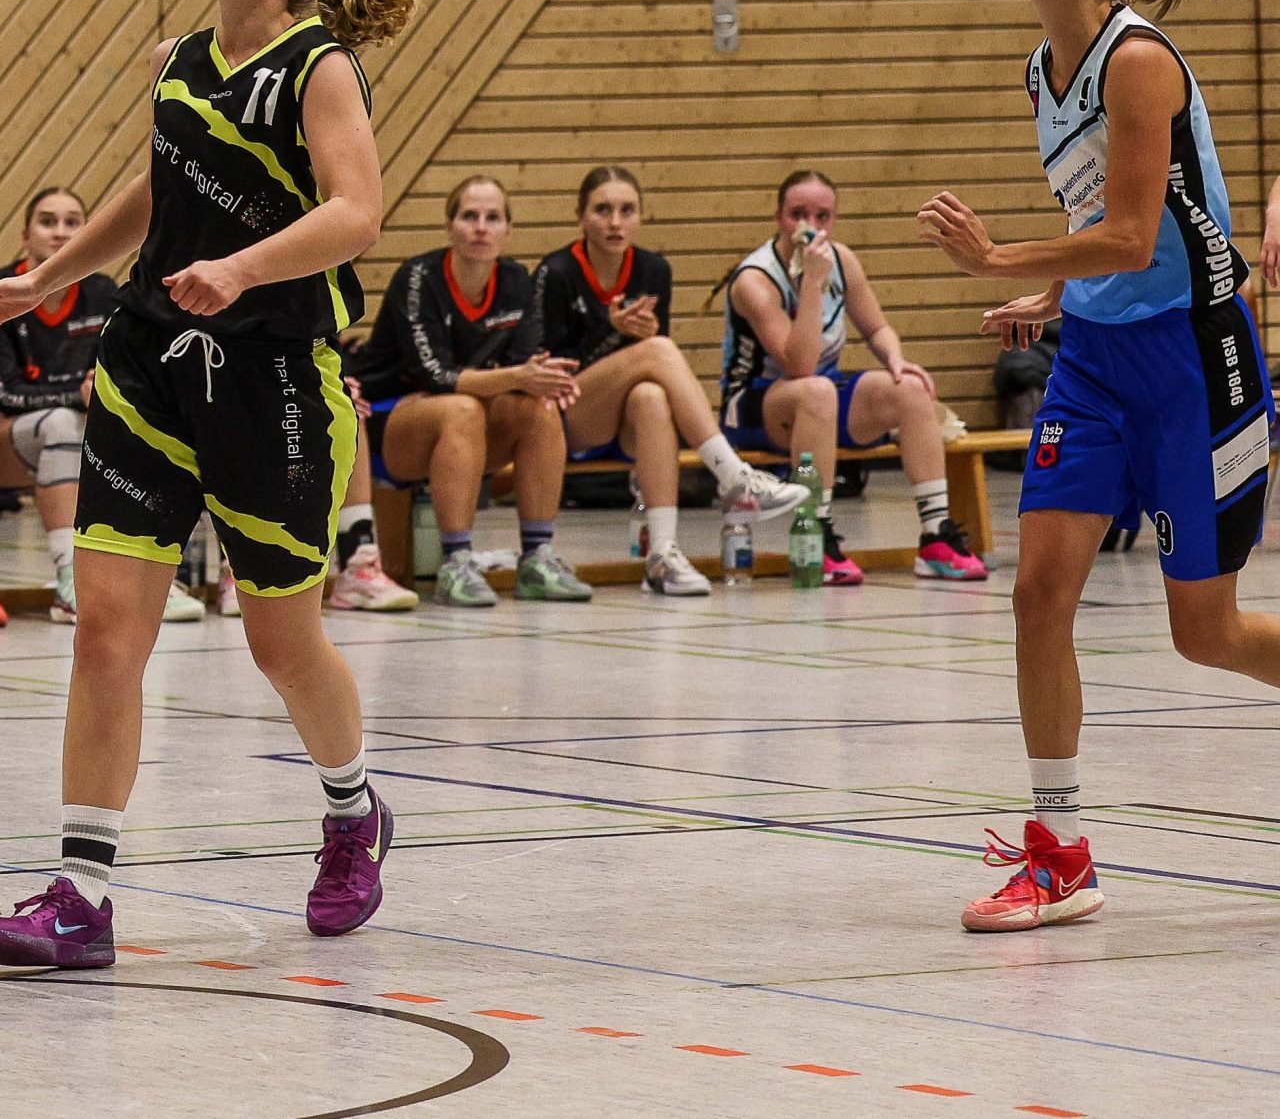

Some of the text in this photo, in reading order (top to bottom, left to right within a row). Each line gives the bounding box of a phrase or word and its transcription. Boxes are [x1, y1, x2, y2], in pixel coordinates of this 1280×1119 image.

[241, 67, 287, 126] 11
[185, 160, 244, 214] digital
[1092, 171, 1106, 187] eG
[1221, 335, 1244, 407] HSB 1846
[281, 402, 303, 459] digital
[1040, 435, 1060, 444] 1846
[1042, 422, 1063, 435] hsb
[103, 468, 147, 502] digital
